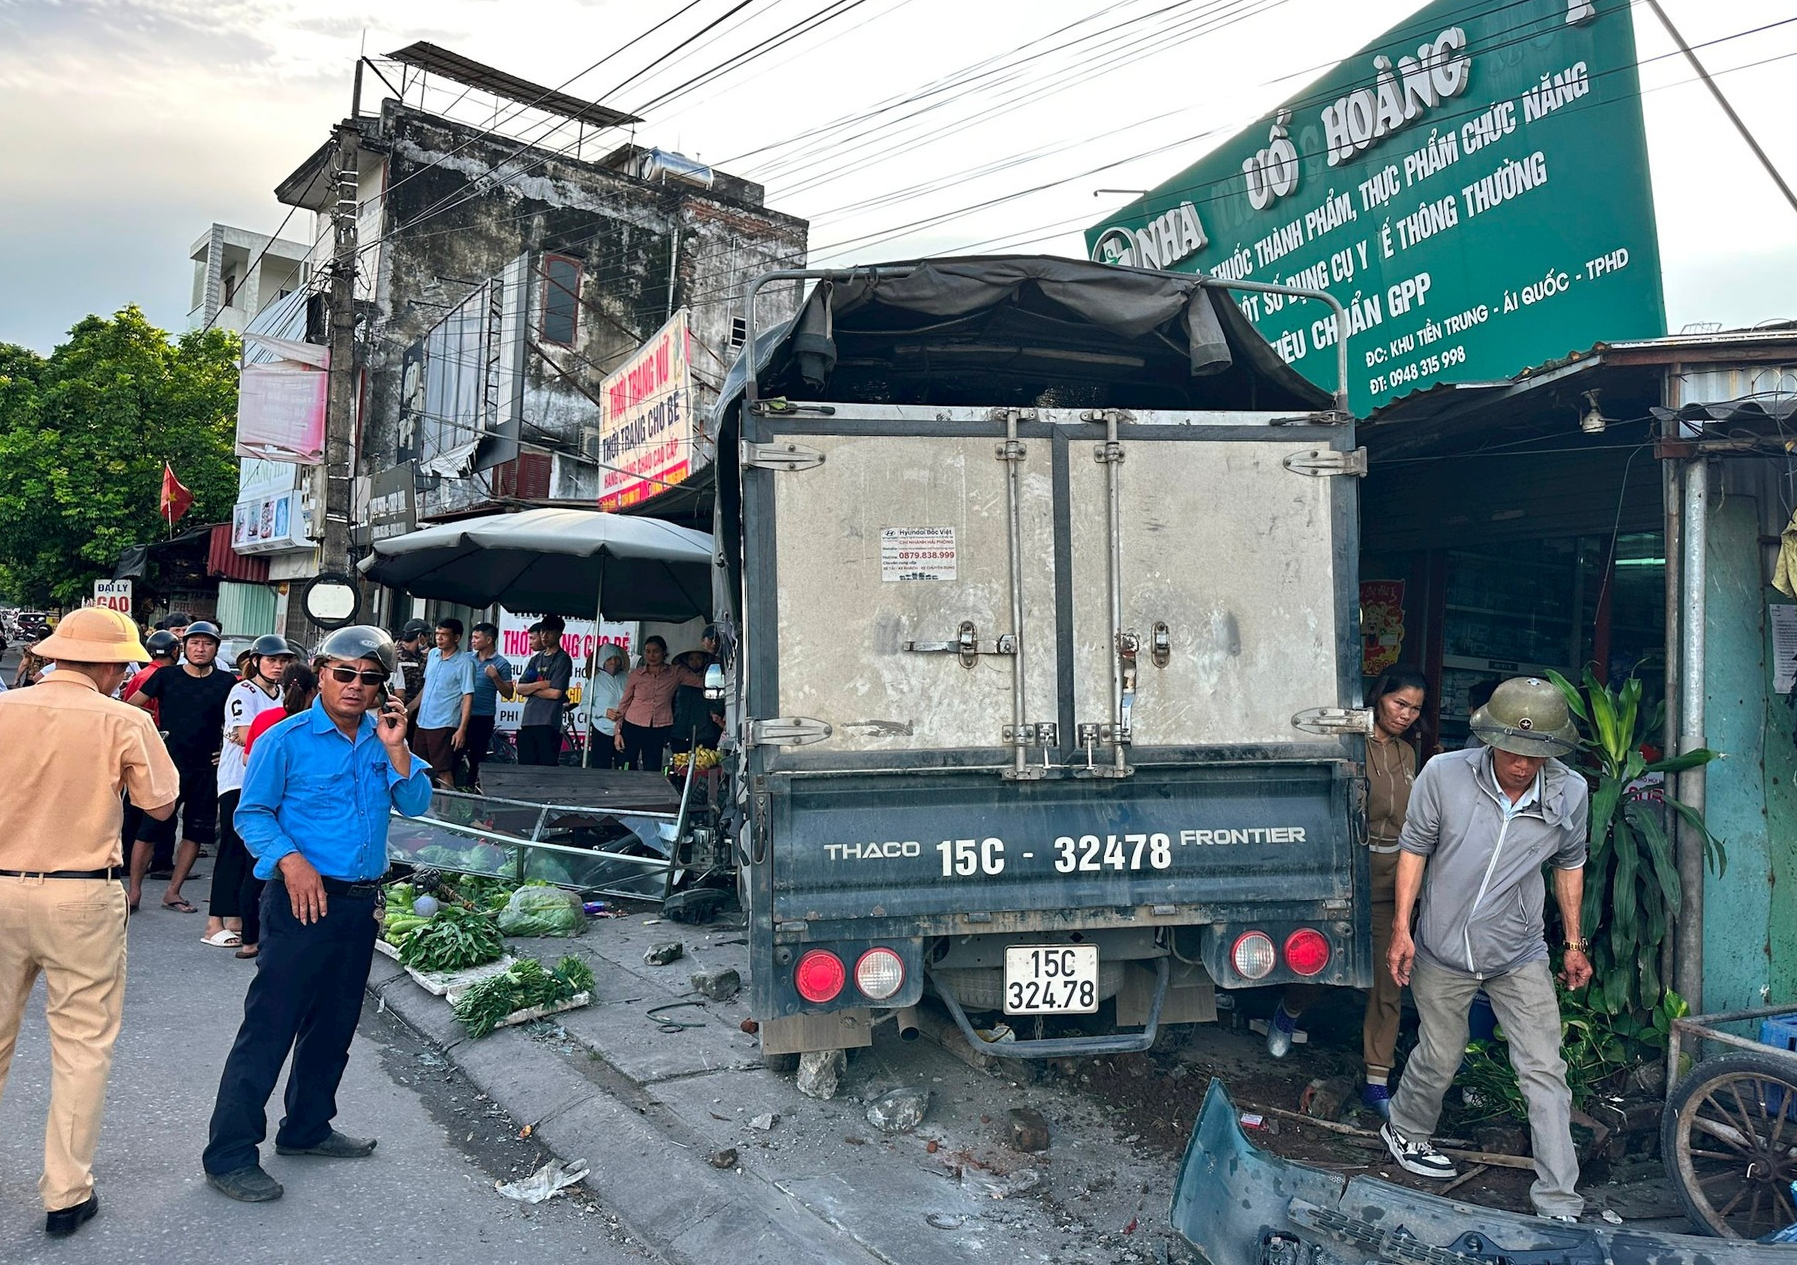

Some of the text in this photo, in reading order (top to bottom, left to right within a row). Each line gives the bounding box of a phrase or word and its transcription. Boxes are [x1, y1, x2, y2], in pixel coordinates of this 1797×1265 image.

[1321, 26, 1472, 167] HOÀNG
[1254, 219, 1304, 268] THÀNH
[1305, 188, 1357, 241] PHẨM,
[1358, 164, 1401, 212] THỰC
[1403, 128, 1459, 188] PHẨM
[1462, 100, 1516, 156] CHỨC
[1522, 61, 1590, 124] NĂNG
[1286, 260, 1330, 305] DỤNG
[1331, 248, 1354, 284] CỤ
[1356, 240, 1368, 270] Y
[1396, 195, 1459, 251] THÔNG
[1462, 151, 1548, 218] THƯỜNG
[1365, 349, 1388, 368] ĐC:
[1390, 334, 1415, 359] KHU
[1416, 318, 1442, 347] TIỀN
[1443, 304, 1489, 337] TRUNG
[1503, 290, 1519, 314] ÁI
[1521, 268, 1570, 306] QUỐC
[1585, 248, 1629, 281] TPHD
[1387, 272, 1431, 318] GPP
[628, 355, 654, 408] TRANG
[1369, 346, 1466, 395] ĐT: 0948 315 998
[603, 383, 680, 463] THỜI TRANG CHO BÉ
[899, 551, 955, 559] 0879.838.999
[98, 582, 128, 593] ĐẠI LÝ
[824, 841, 921, 861] THACO
[936, 837, 1005, 876] 15C
[1054, 833, 1171, 874] 32478
[1180, 826, 1306, 847] FRONTIER
[1031, 950, 1076, 978] 15C
[1008, 981, 1095, 1011] 324.78
